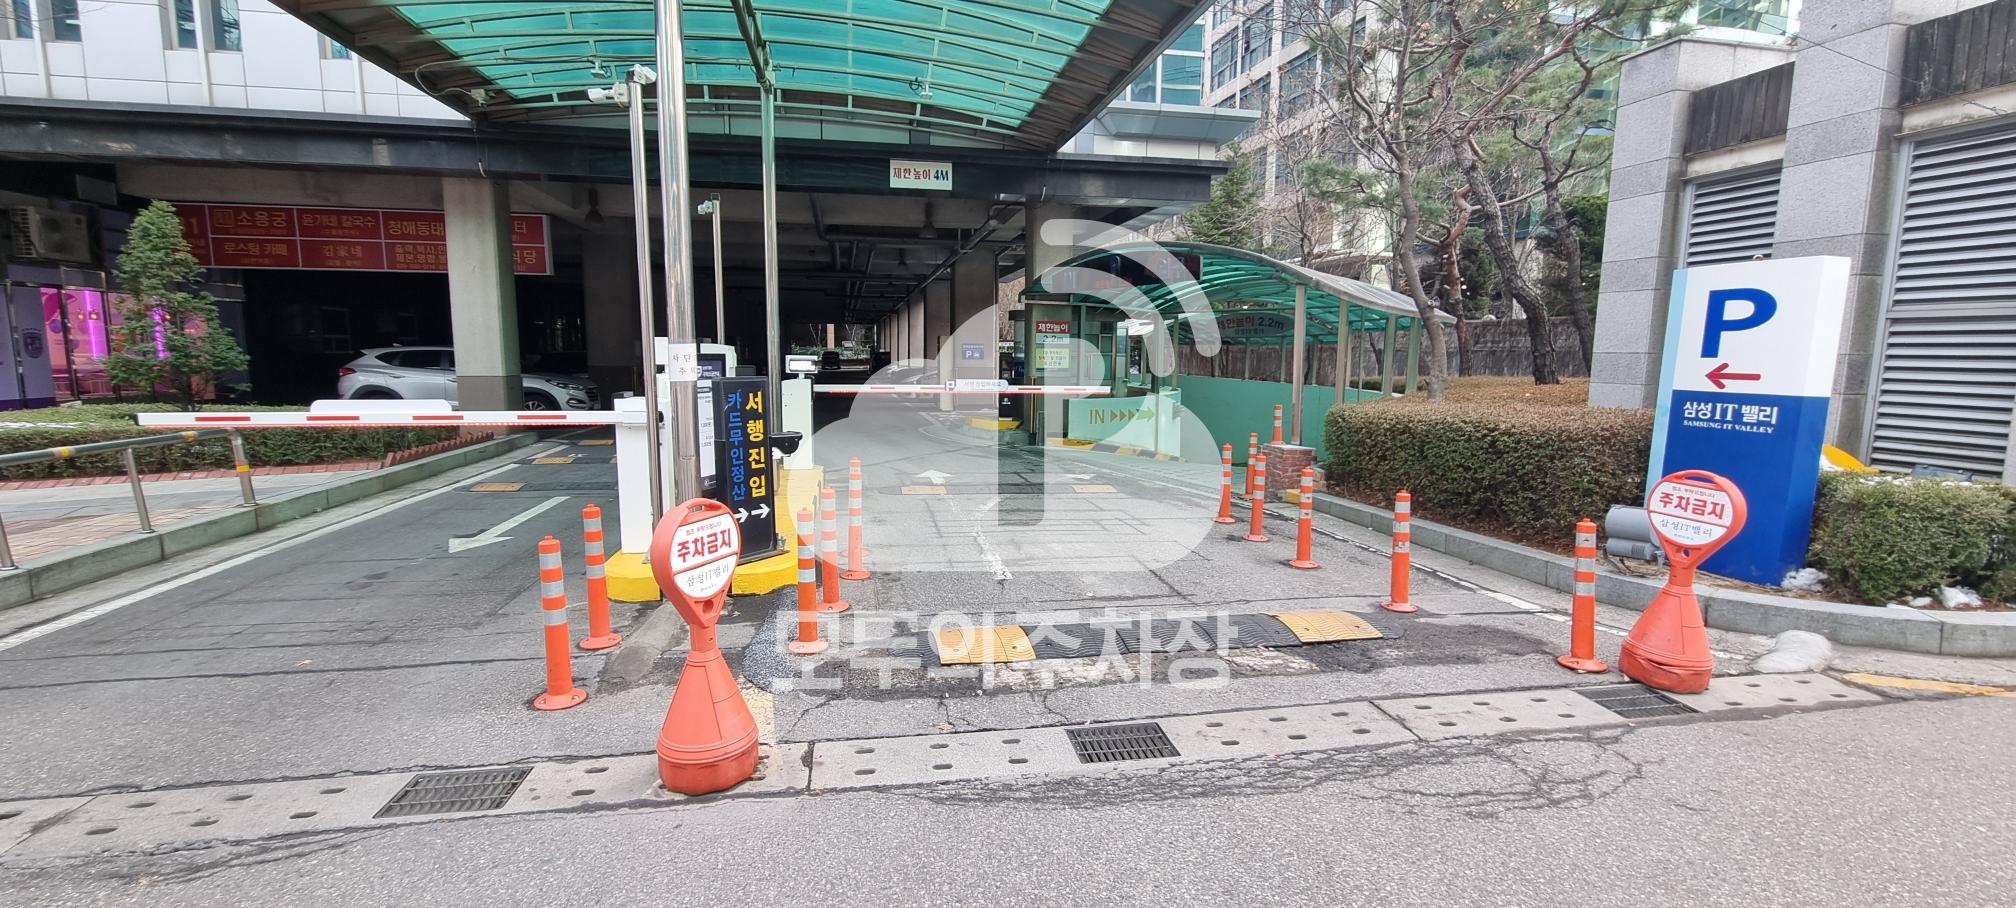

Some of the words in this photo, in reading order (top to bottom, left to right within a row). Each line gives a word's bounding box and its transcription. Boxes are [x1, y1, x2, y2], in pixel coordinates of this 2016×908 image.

[934, 169, 949, 181] 4M
[236, 210, 288, 227] 소용궁
[1700, 287, 1778, 358] P
[1042, 334, 1064, 343] 2.2m
[1089, 408, 1105, 425] IN
[1741, 404, 1779, 425] 밸리
[1683, 420, 1722, 429] SAMSUNG
[1734, 424, 1774, 434] VALLEY
[1659, 491, 1725, 520] 주차금지
[677, 528, 732, 563] 주차금지
